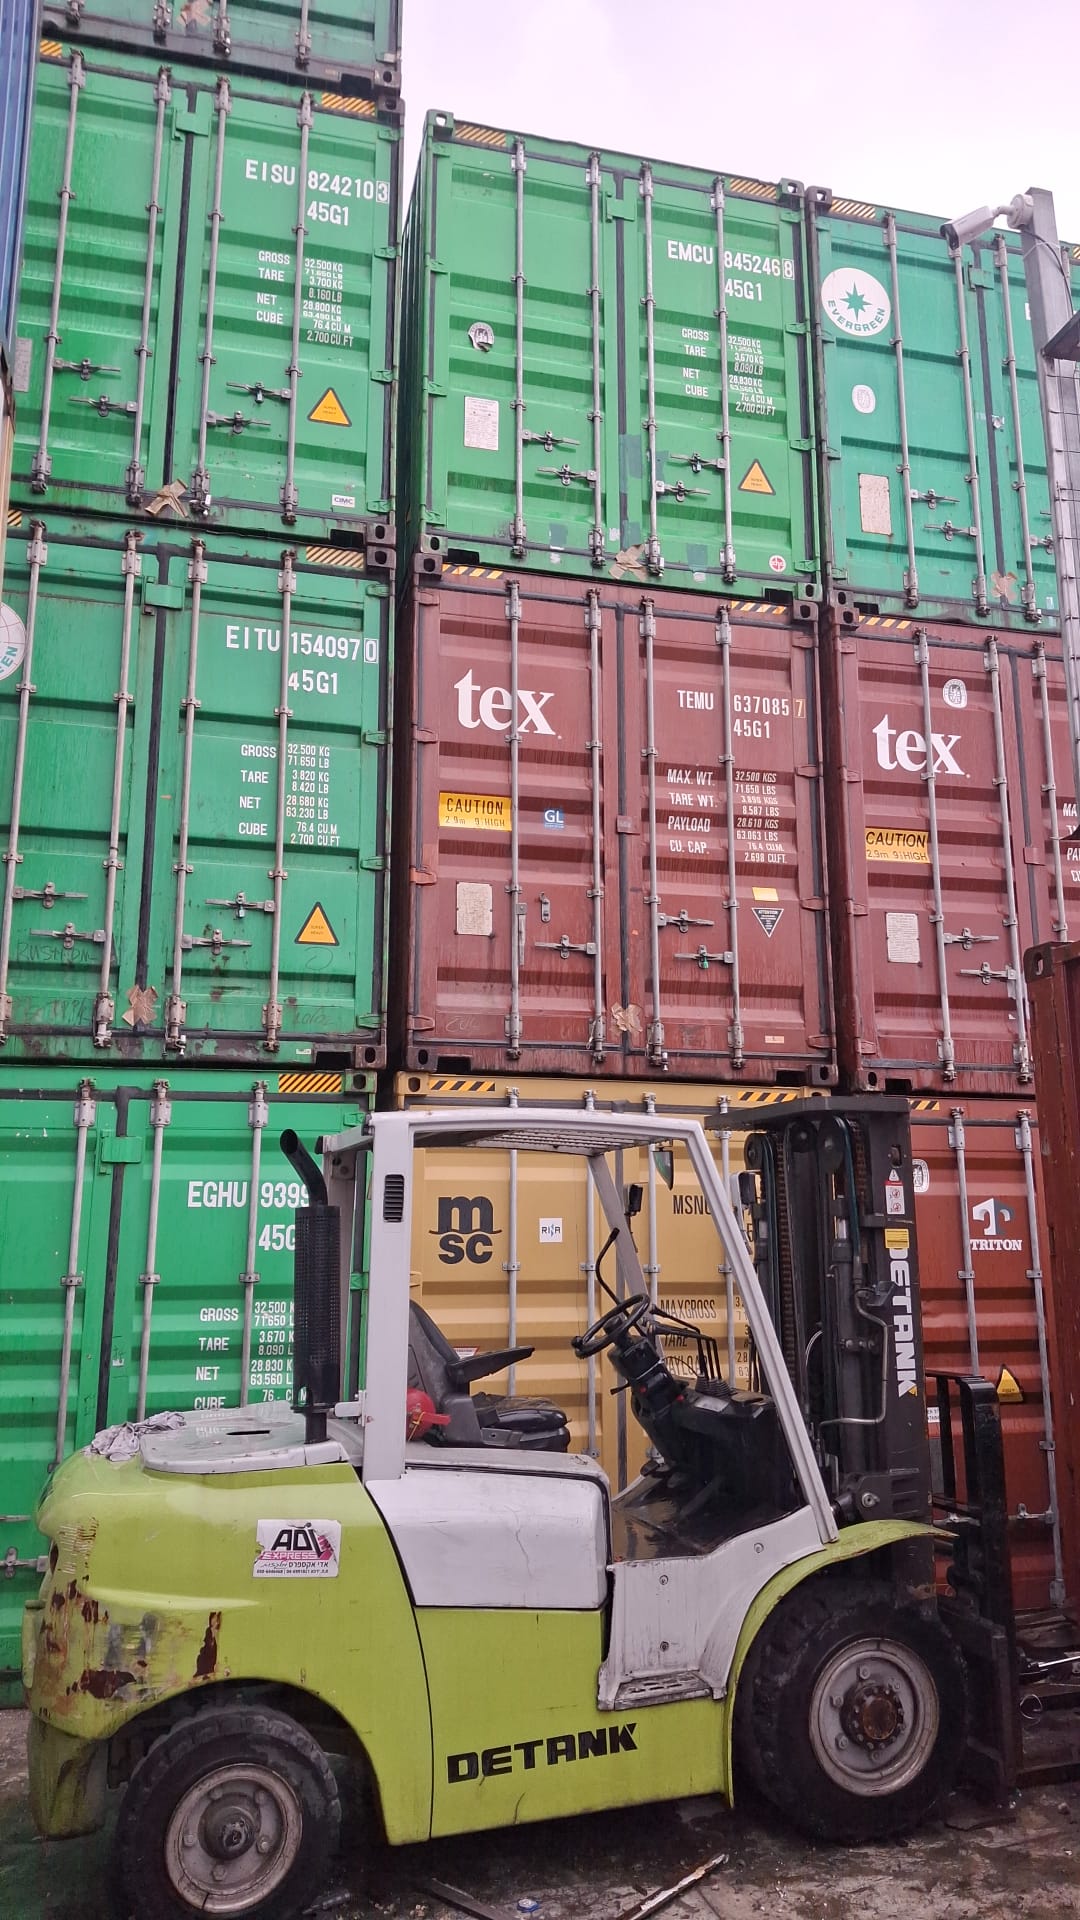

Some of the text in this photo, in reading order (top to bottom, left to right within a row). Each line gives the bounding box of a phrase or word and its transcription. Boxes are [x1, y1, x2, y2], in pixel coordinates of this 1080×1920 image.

[246, 159, 295, 185] EISU
[307, 201, 349, 226] 45G1
[667, 240, 713, 265] EMCU
[258, 250, 343, 273] GROSS 32.500 KG
[258, 268, 285, 281] TARE
[332, 279, 343, 290] KG
[331, 290, 343, 303] LB
[724, 278, 762, 301] 45G1
[256, 292, 277, 305] NET
[331, 304, 342, 315] KG
[256, 311, 284, 325] CUBE
[828, 299, 886, 332] EVERGREEN
[681, 328, 709, 341] GROSS
[752, 339, 761, 349] KG
[684, 344, 707, 357] TARE
[754, 355, 764, 365] KG
[682, 367, 700, 380] NET
[753, 378, 763, 388] KG
[754, 364, 763, 376] LB
[685, 384, 709, 397] CUBE
[226, 624, 280, 652] EITU
[288, 669, 338, 695] 45G1
[677, 689, 714, 711] TEMU
[733, 719, 770, 739] 45G1
[241, 743, 330, 758] GROSS 32.500 KG
[287, 755, 330, 769] 71.650 LB
[240, 769, 330, 784] TARE 3.820 KG
[667, 768, 693, 785] MAX.
[696, 770, 715, 787] WT.
[762, 772, 777, 783] KGS
[292, 781, 329, 794] 8.420 LB
[762, 785, 776, 795] LBS
[239, 795, 329, 809] NET 28.680 KG
[447, 797, 503, 815] CAUTION
[668, 792, 693, 806] TARE
[697, 794, 717, 808] WT.
[286, 806, 328, 820] 63.230 LB
[544, 810, 564, 824] GL
[765, 806, 779, 817] LBS
[238, 822, 268, 836] CUBE
[296, 821, 314, 833] 76.4
[667, 815, 711, 833] PAYLOAD
[764, 819, 779, 829] KGS
[290, 832, 314, 845] 2.700
[764, 831, 778, 842] LBS
[866, 831, 926, 847] CAUTION
[669, 839, 685, 853] CU.
[688, 840, 710, 855] CAP.
[187, 1181, 310, 1208] EGHU 9399
[258, 1224, 296, 1251] 45G
[970, 1239, 1022, 1251] TRITON
[200, 1307, 239, 1322] GROSS
[254, 1301, 286, 1314] 32.500
[254, 1315, 286, 1327] 71.650
[198, 1337, 230, 1351] TARE
[259, 1331, 285, 1343] 3.670
[258, 1344, 284, 1356] 8.090
[195, 1366, 220, 1381] NET
[251, 1360, 283, 1372] 28.830
[250, 1373, 283, 1386] 63.560
[194, 1396, 226, 1410] CUBE
[261, 1551, 318, 1560] EXPRESS
[447, 1722, 638, 1784] DETANK
